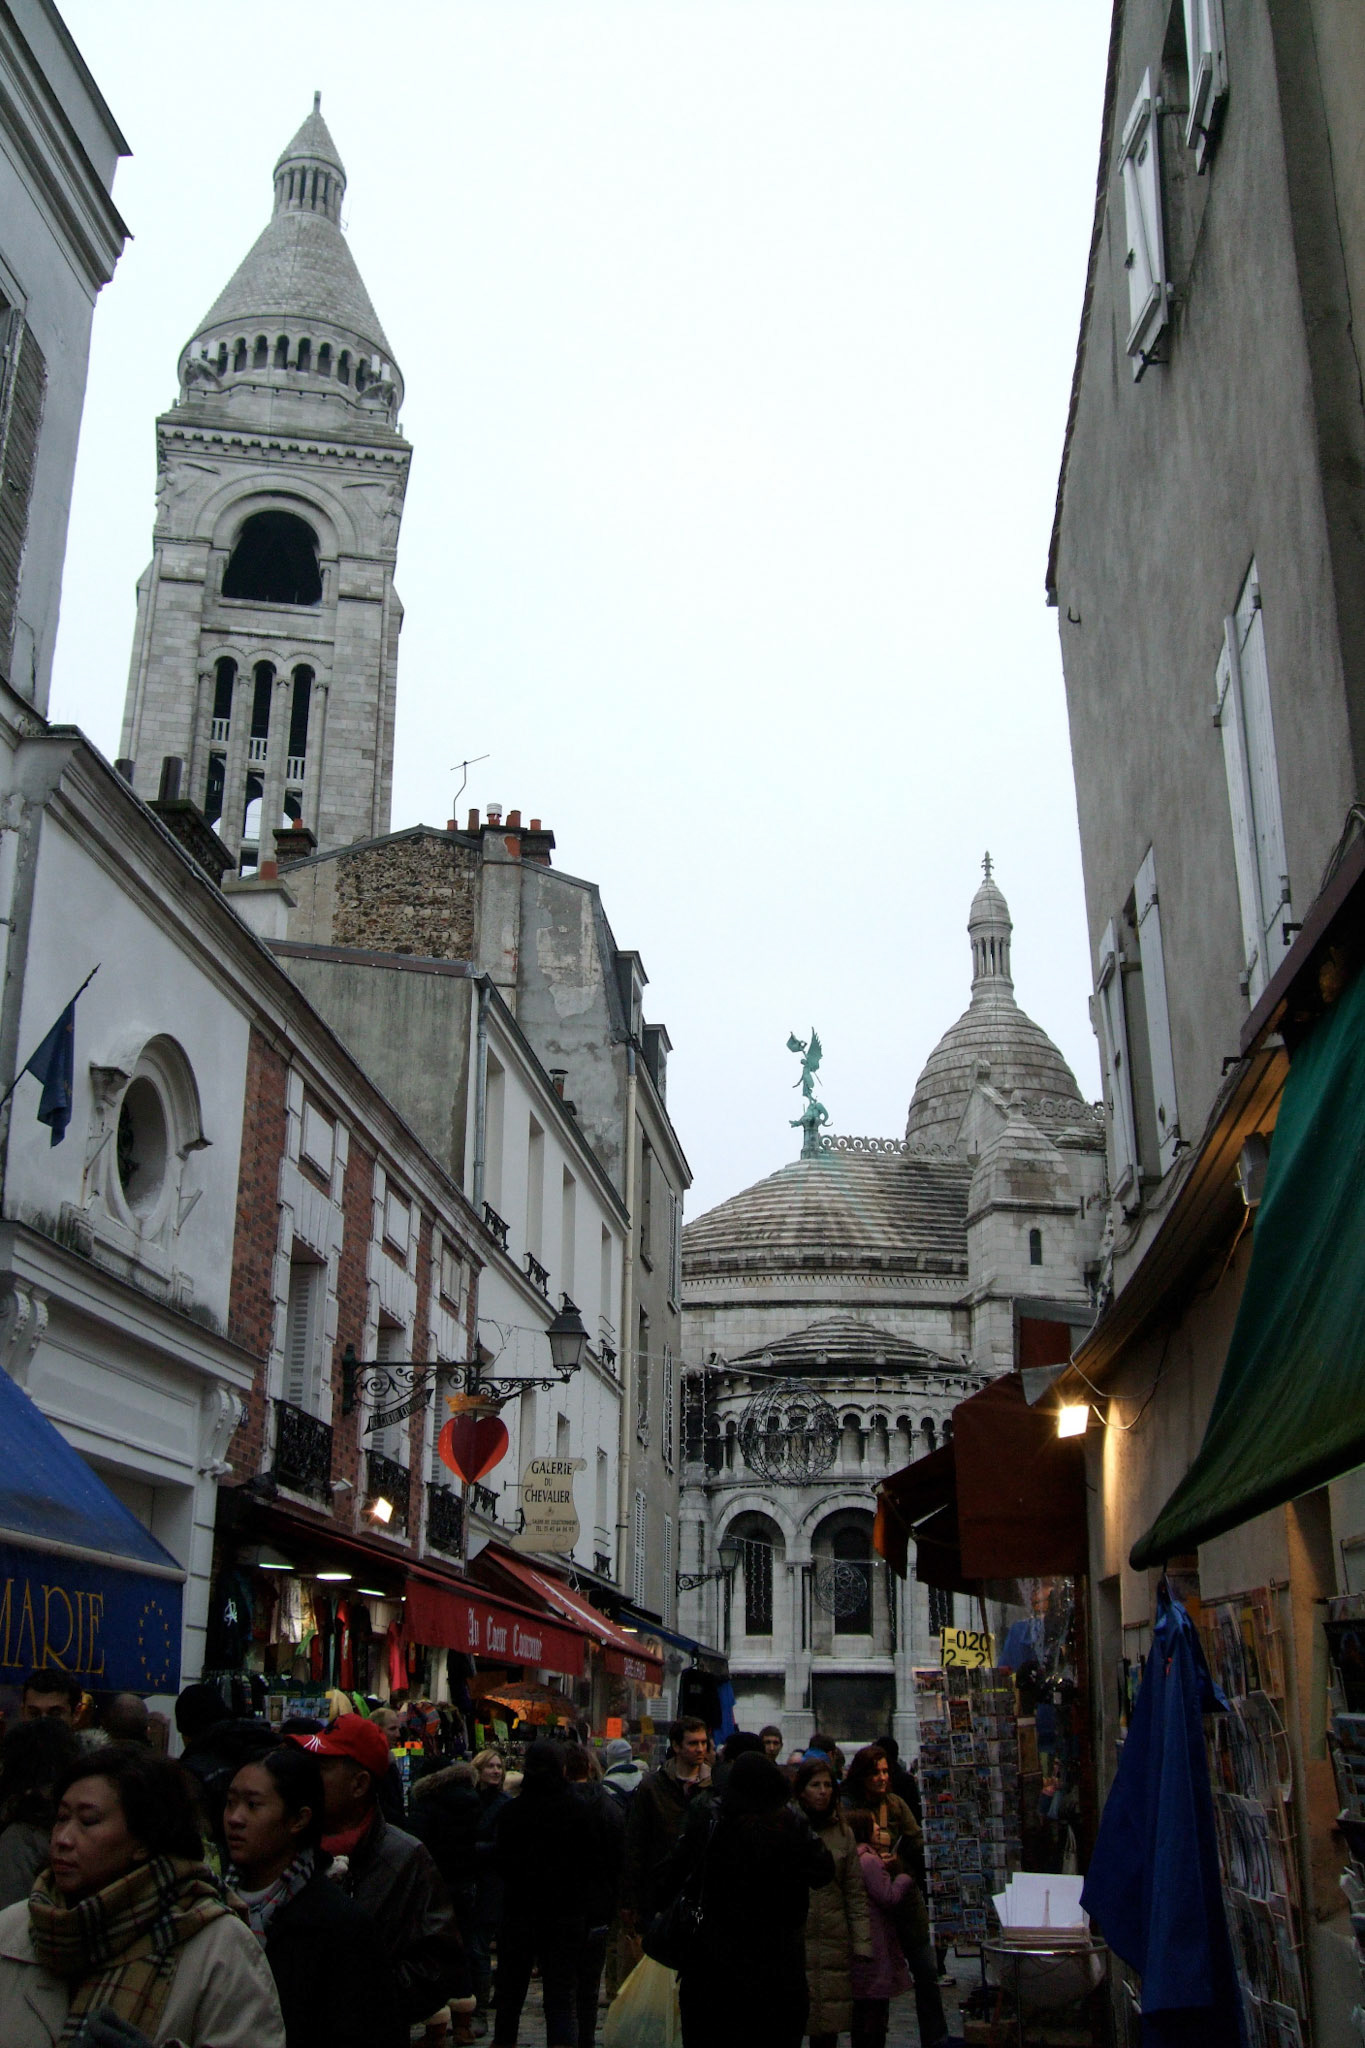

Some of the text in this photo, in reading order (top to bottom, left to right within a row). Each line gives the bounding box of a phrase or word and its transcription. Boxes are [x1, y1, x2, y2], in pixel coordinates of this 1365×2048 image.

[531, 1460, 573, 1475] GALERIE
[544, 1477, 553, 1487] DU
[524, 1488, 570, 1504] CHEVALIER
[468, 1607, 480, 1646] Au
